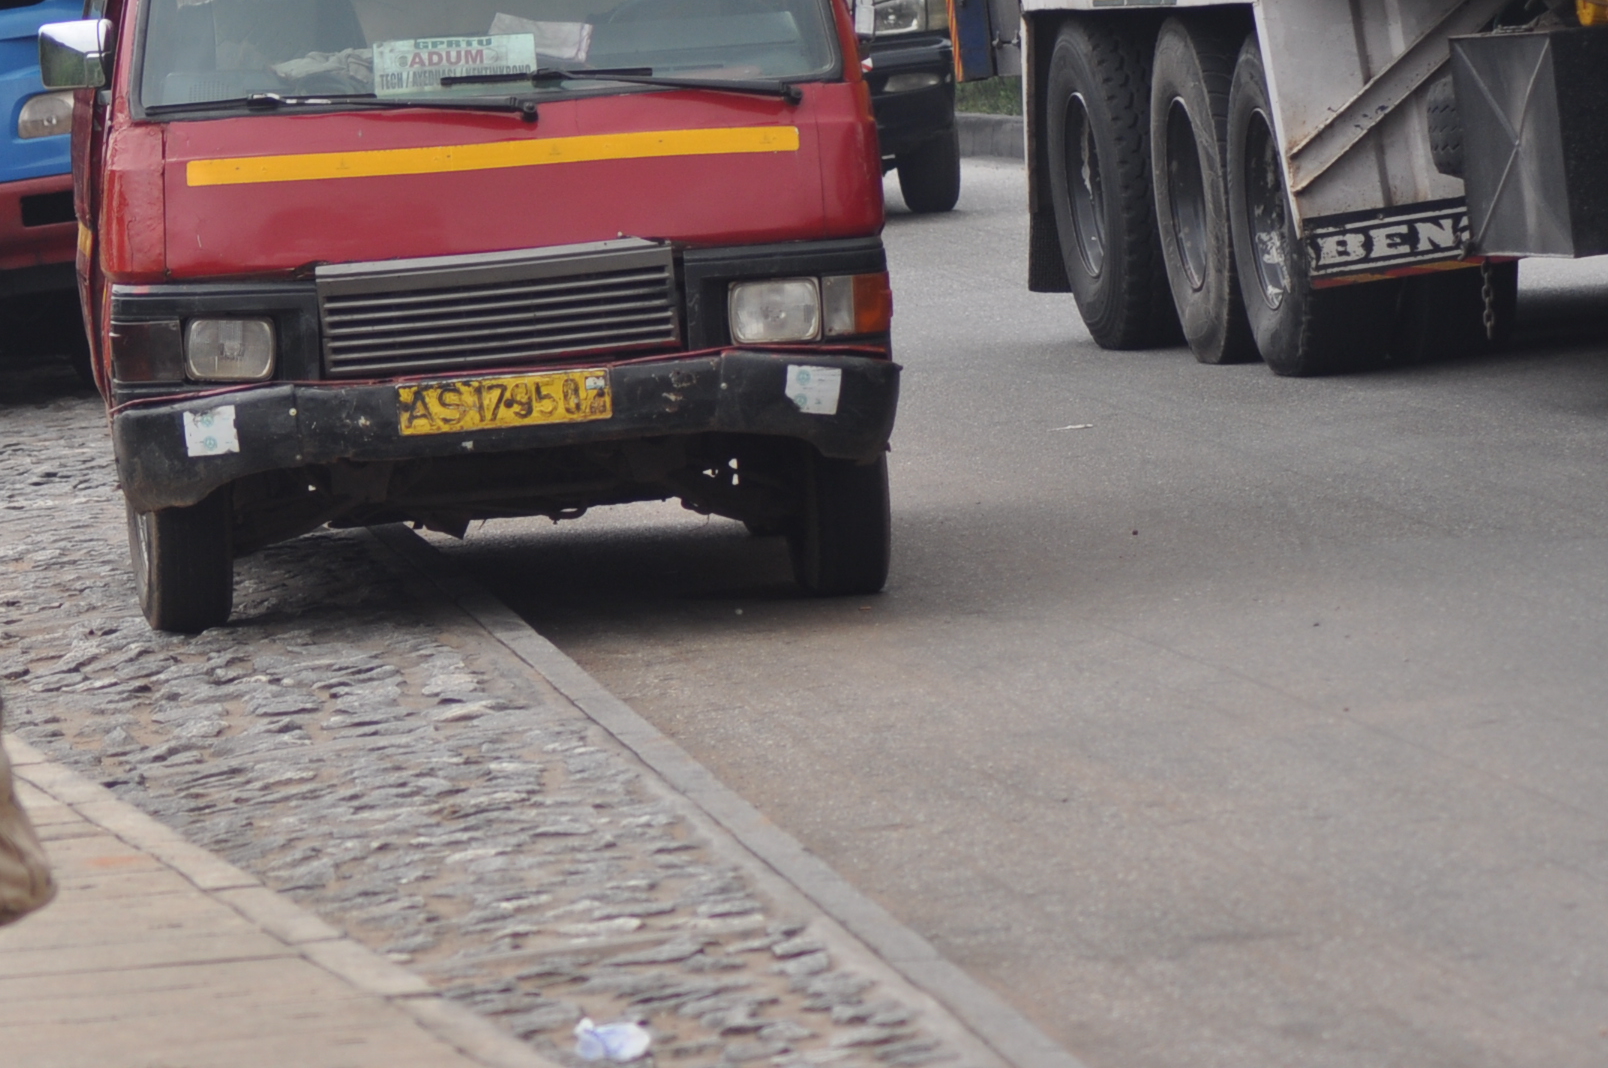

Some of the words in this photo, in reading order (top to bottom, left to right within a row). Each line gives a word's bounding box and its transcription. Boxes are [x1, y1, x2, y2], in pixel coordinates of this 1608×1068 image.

[416, 37, 492, 50] GPRTU
[409, 49, 484, 68] ADUM
[379, 72, 403, 90] TECH
